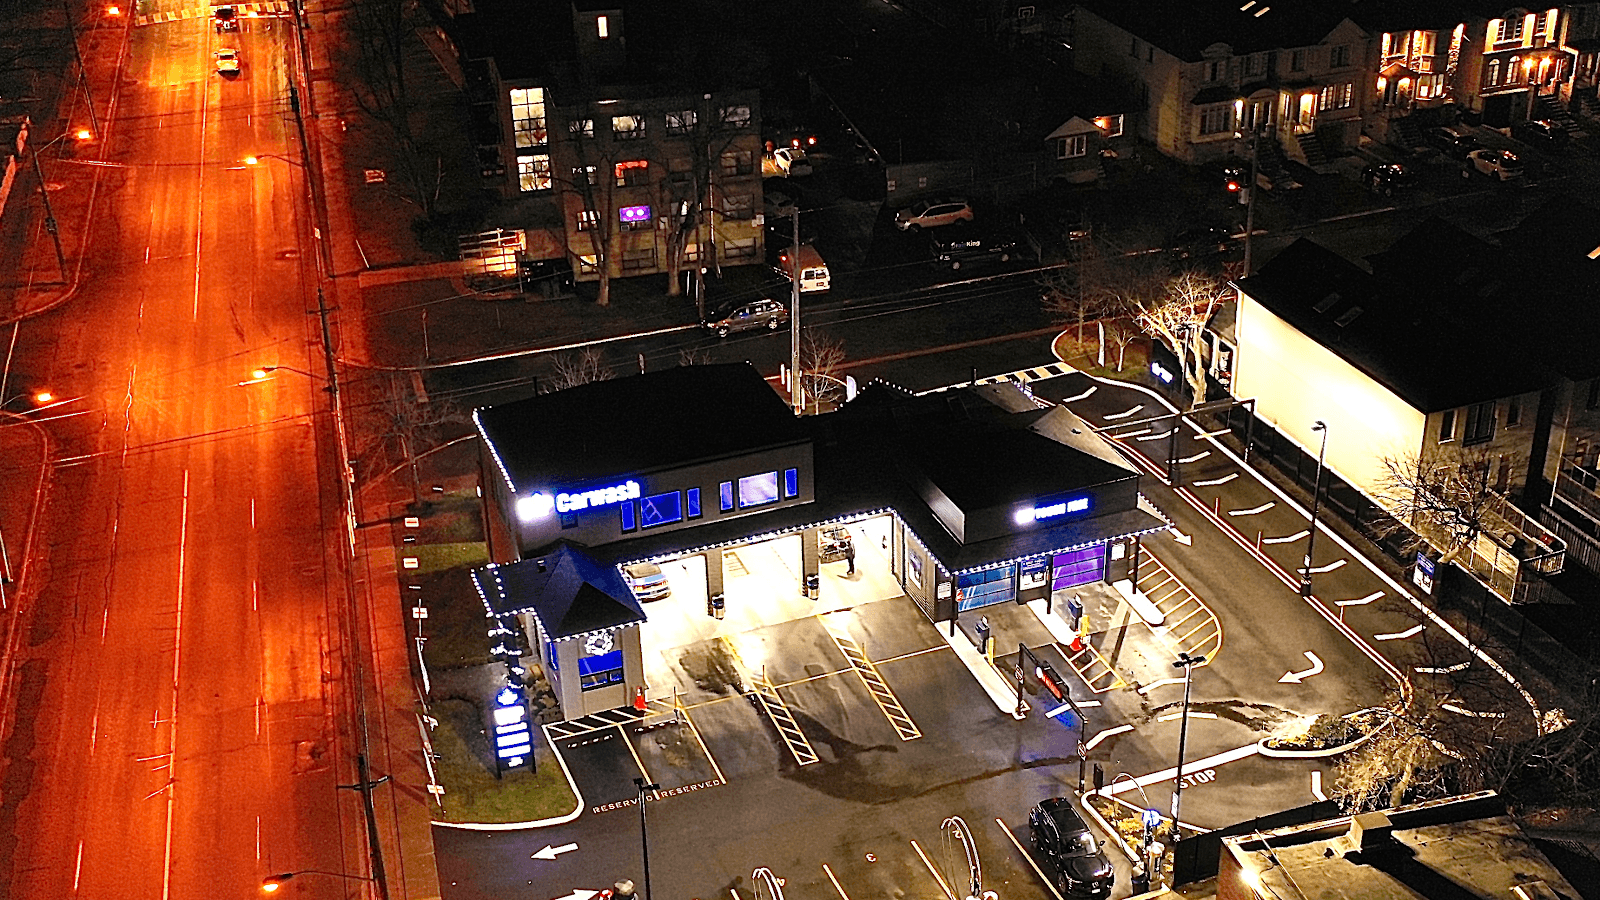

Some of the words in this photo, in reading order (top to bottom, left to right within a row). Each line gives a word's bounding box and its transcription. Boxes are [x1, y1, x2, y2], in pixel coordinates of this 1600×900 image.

[556, 480, 641, 512] Carwash
[661, 779, 720, 798] RESERVED
[1173, 769, 1216, 789] STOP
[592, 794, 653, 814] RESERVD
